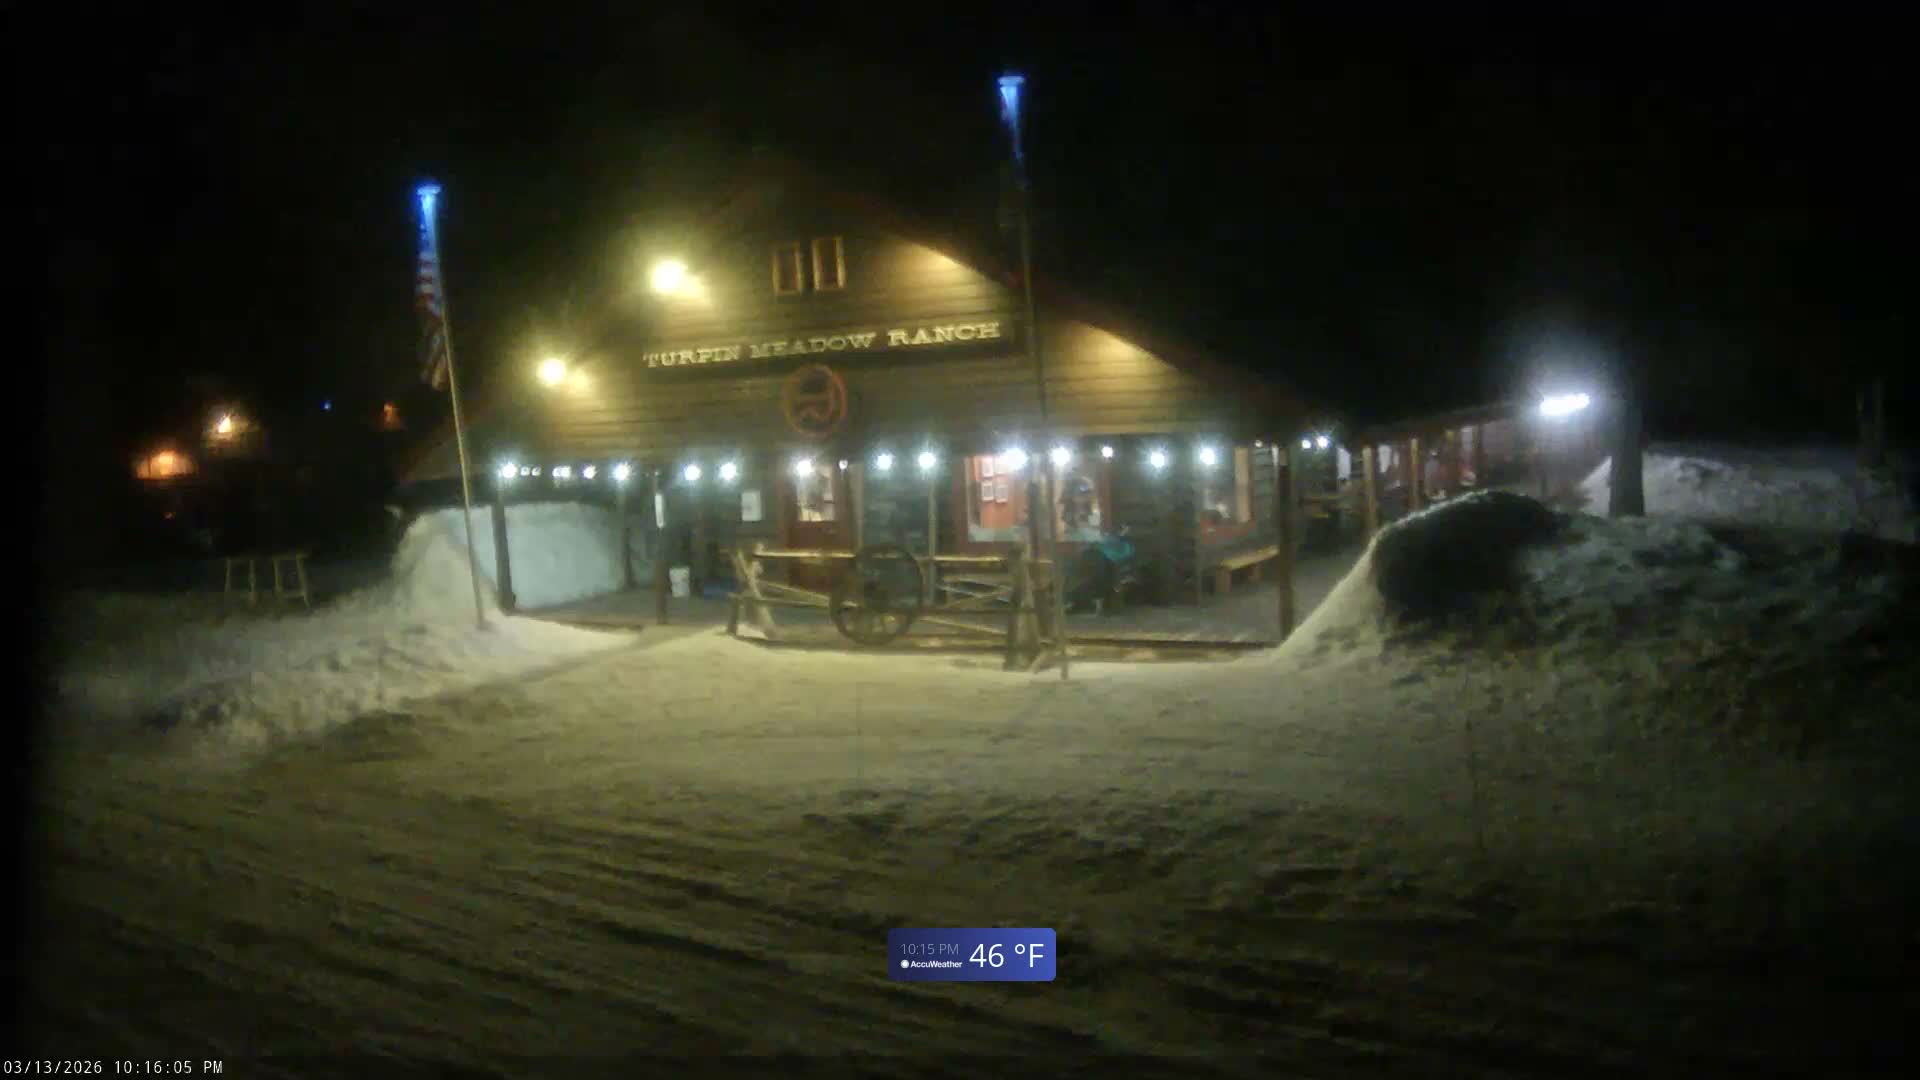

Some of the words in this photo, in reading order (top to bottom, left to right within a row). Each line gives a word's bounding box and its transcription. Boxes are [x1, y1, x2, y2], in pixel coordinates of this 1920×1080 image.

[643, 344, 741, 368] TURPIN
[749, 331, 876, 359] MEADOW
[887, 321, 1001, 347] RANCH
